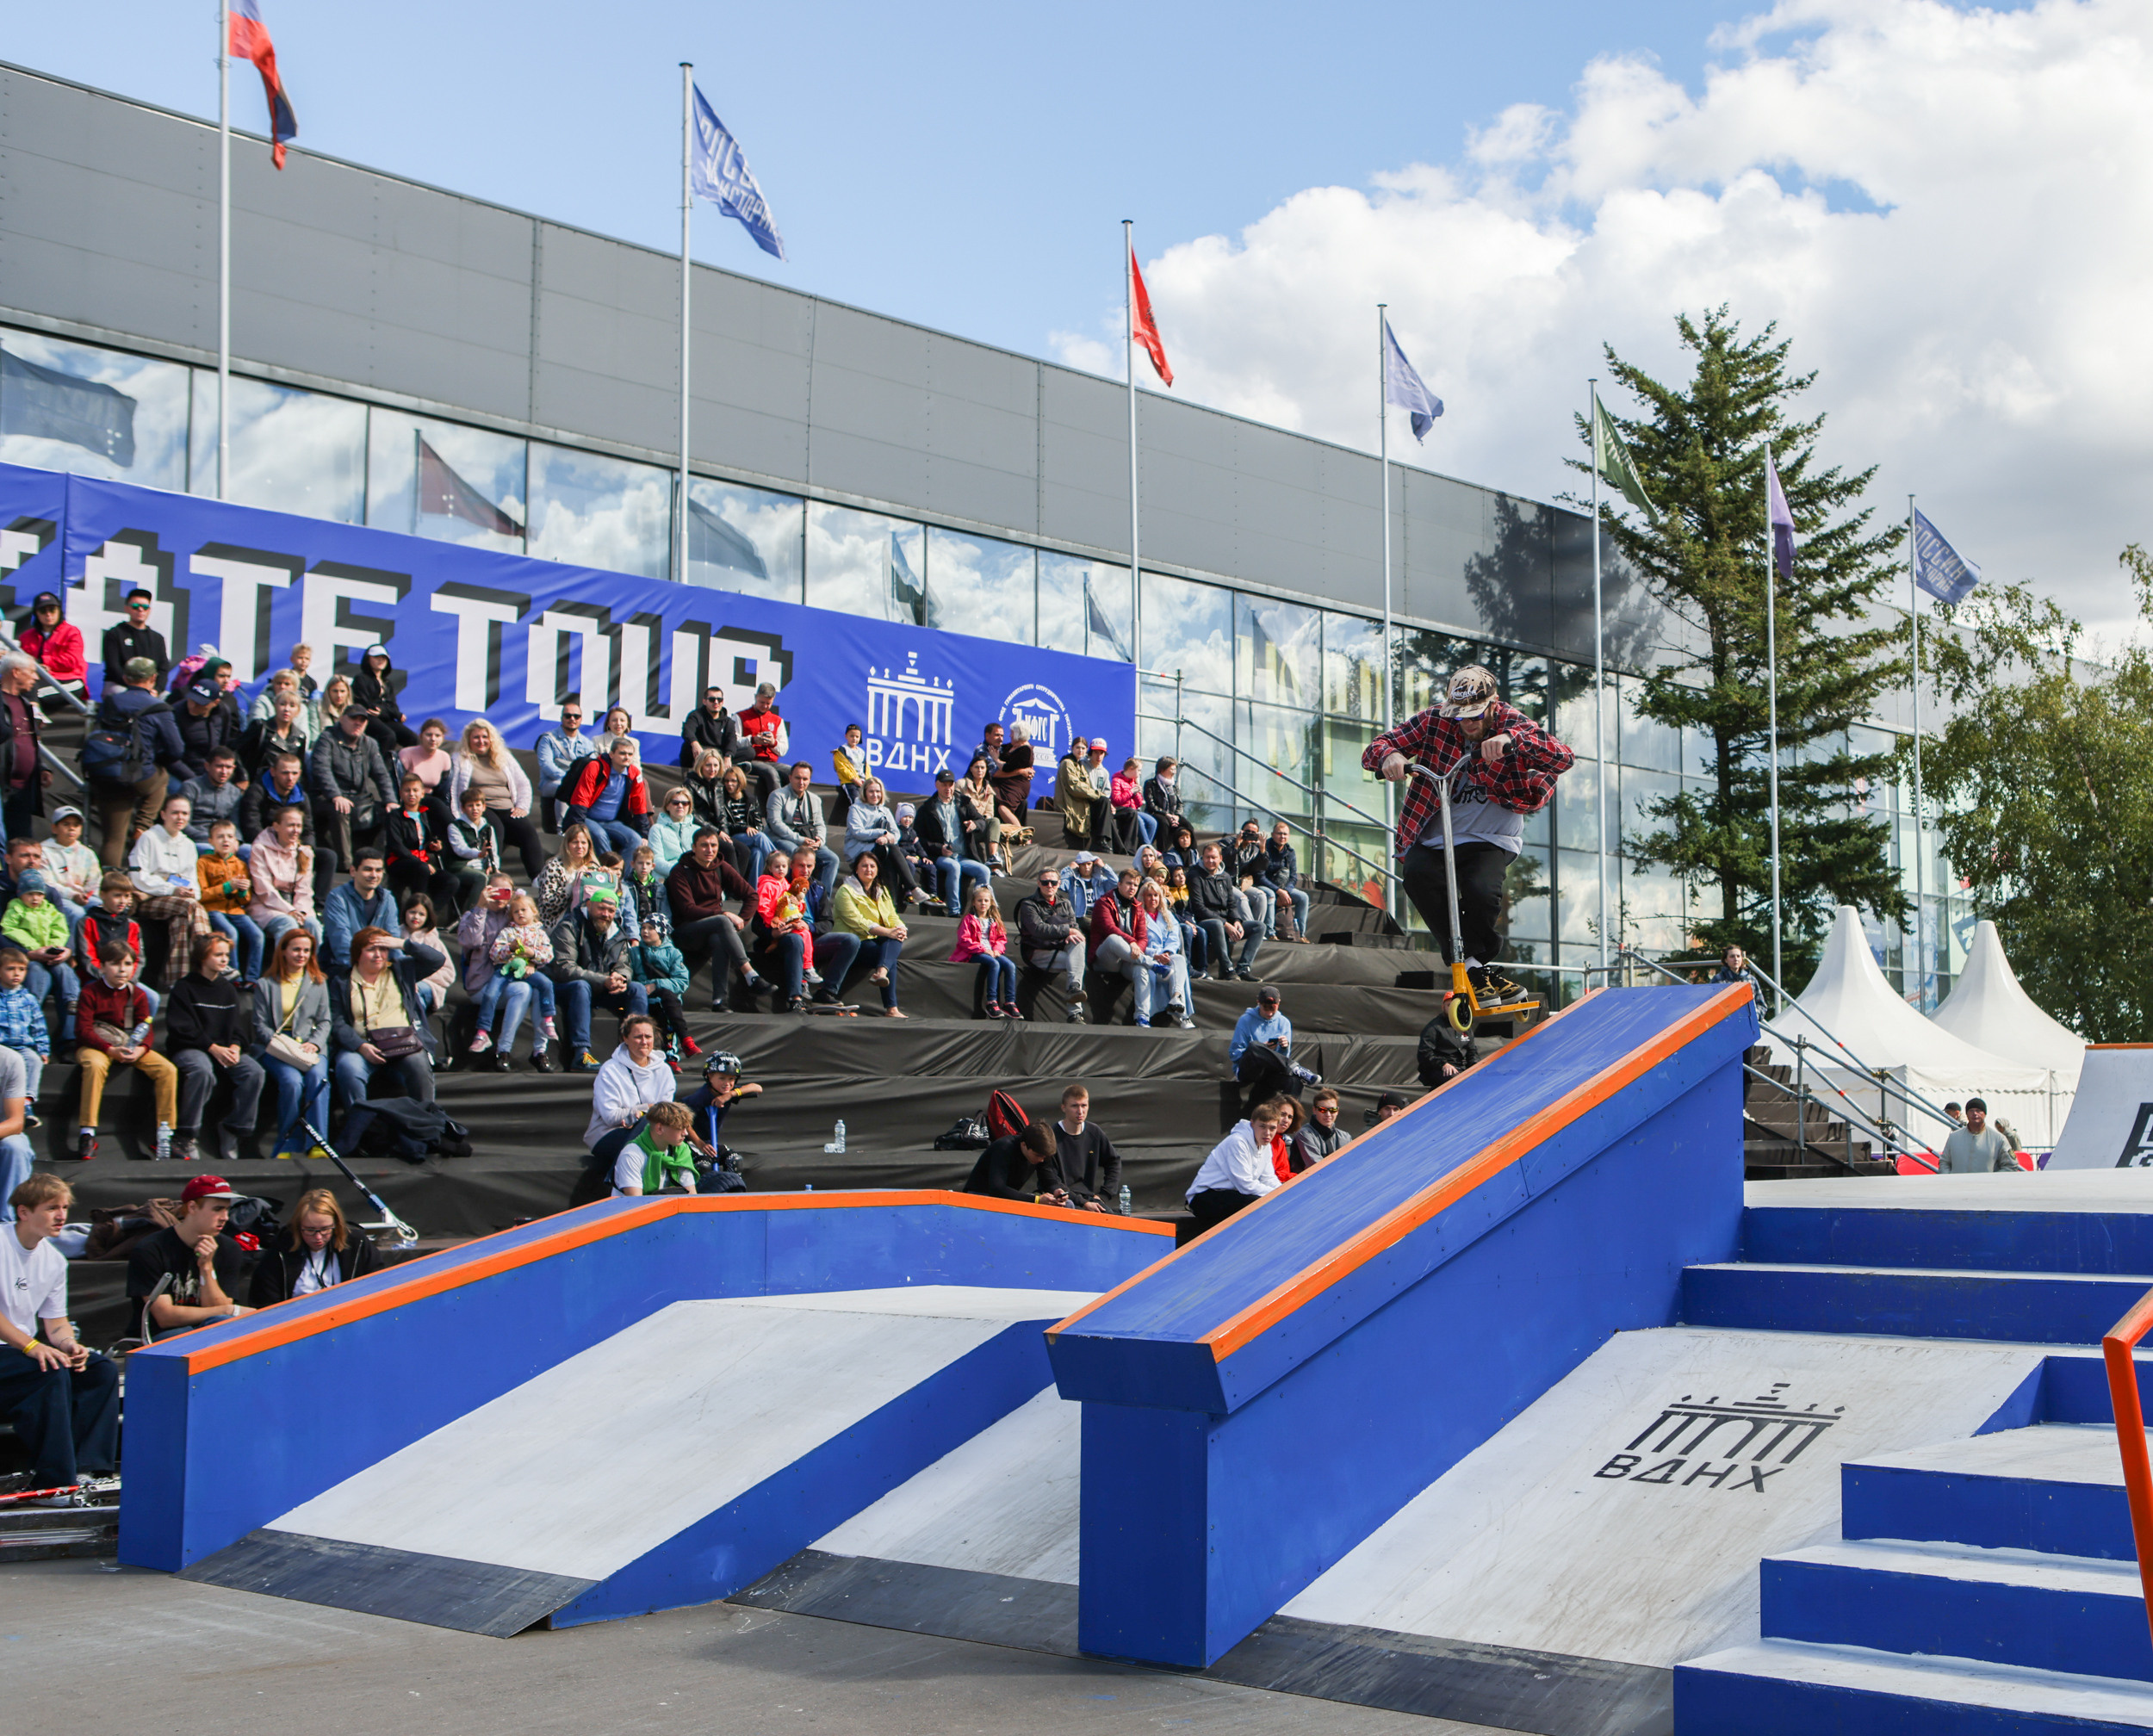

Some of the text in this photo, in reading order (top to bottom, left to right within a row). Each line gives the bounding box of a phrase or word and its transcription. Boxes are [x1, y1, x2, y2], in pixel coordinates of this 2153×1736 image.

[718, 179, 777, 233] ИСТОРИ
[430, 592, 783, 737] TOUR
[866, 737, 951, 775] ВДНХ
[1593, 1454, 1785, 1492] ВДНХ
